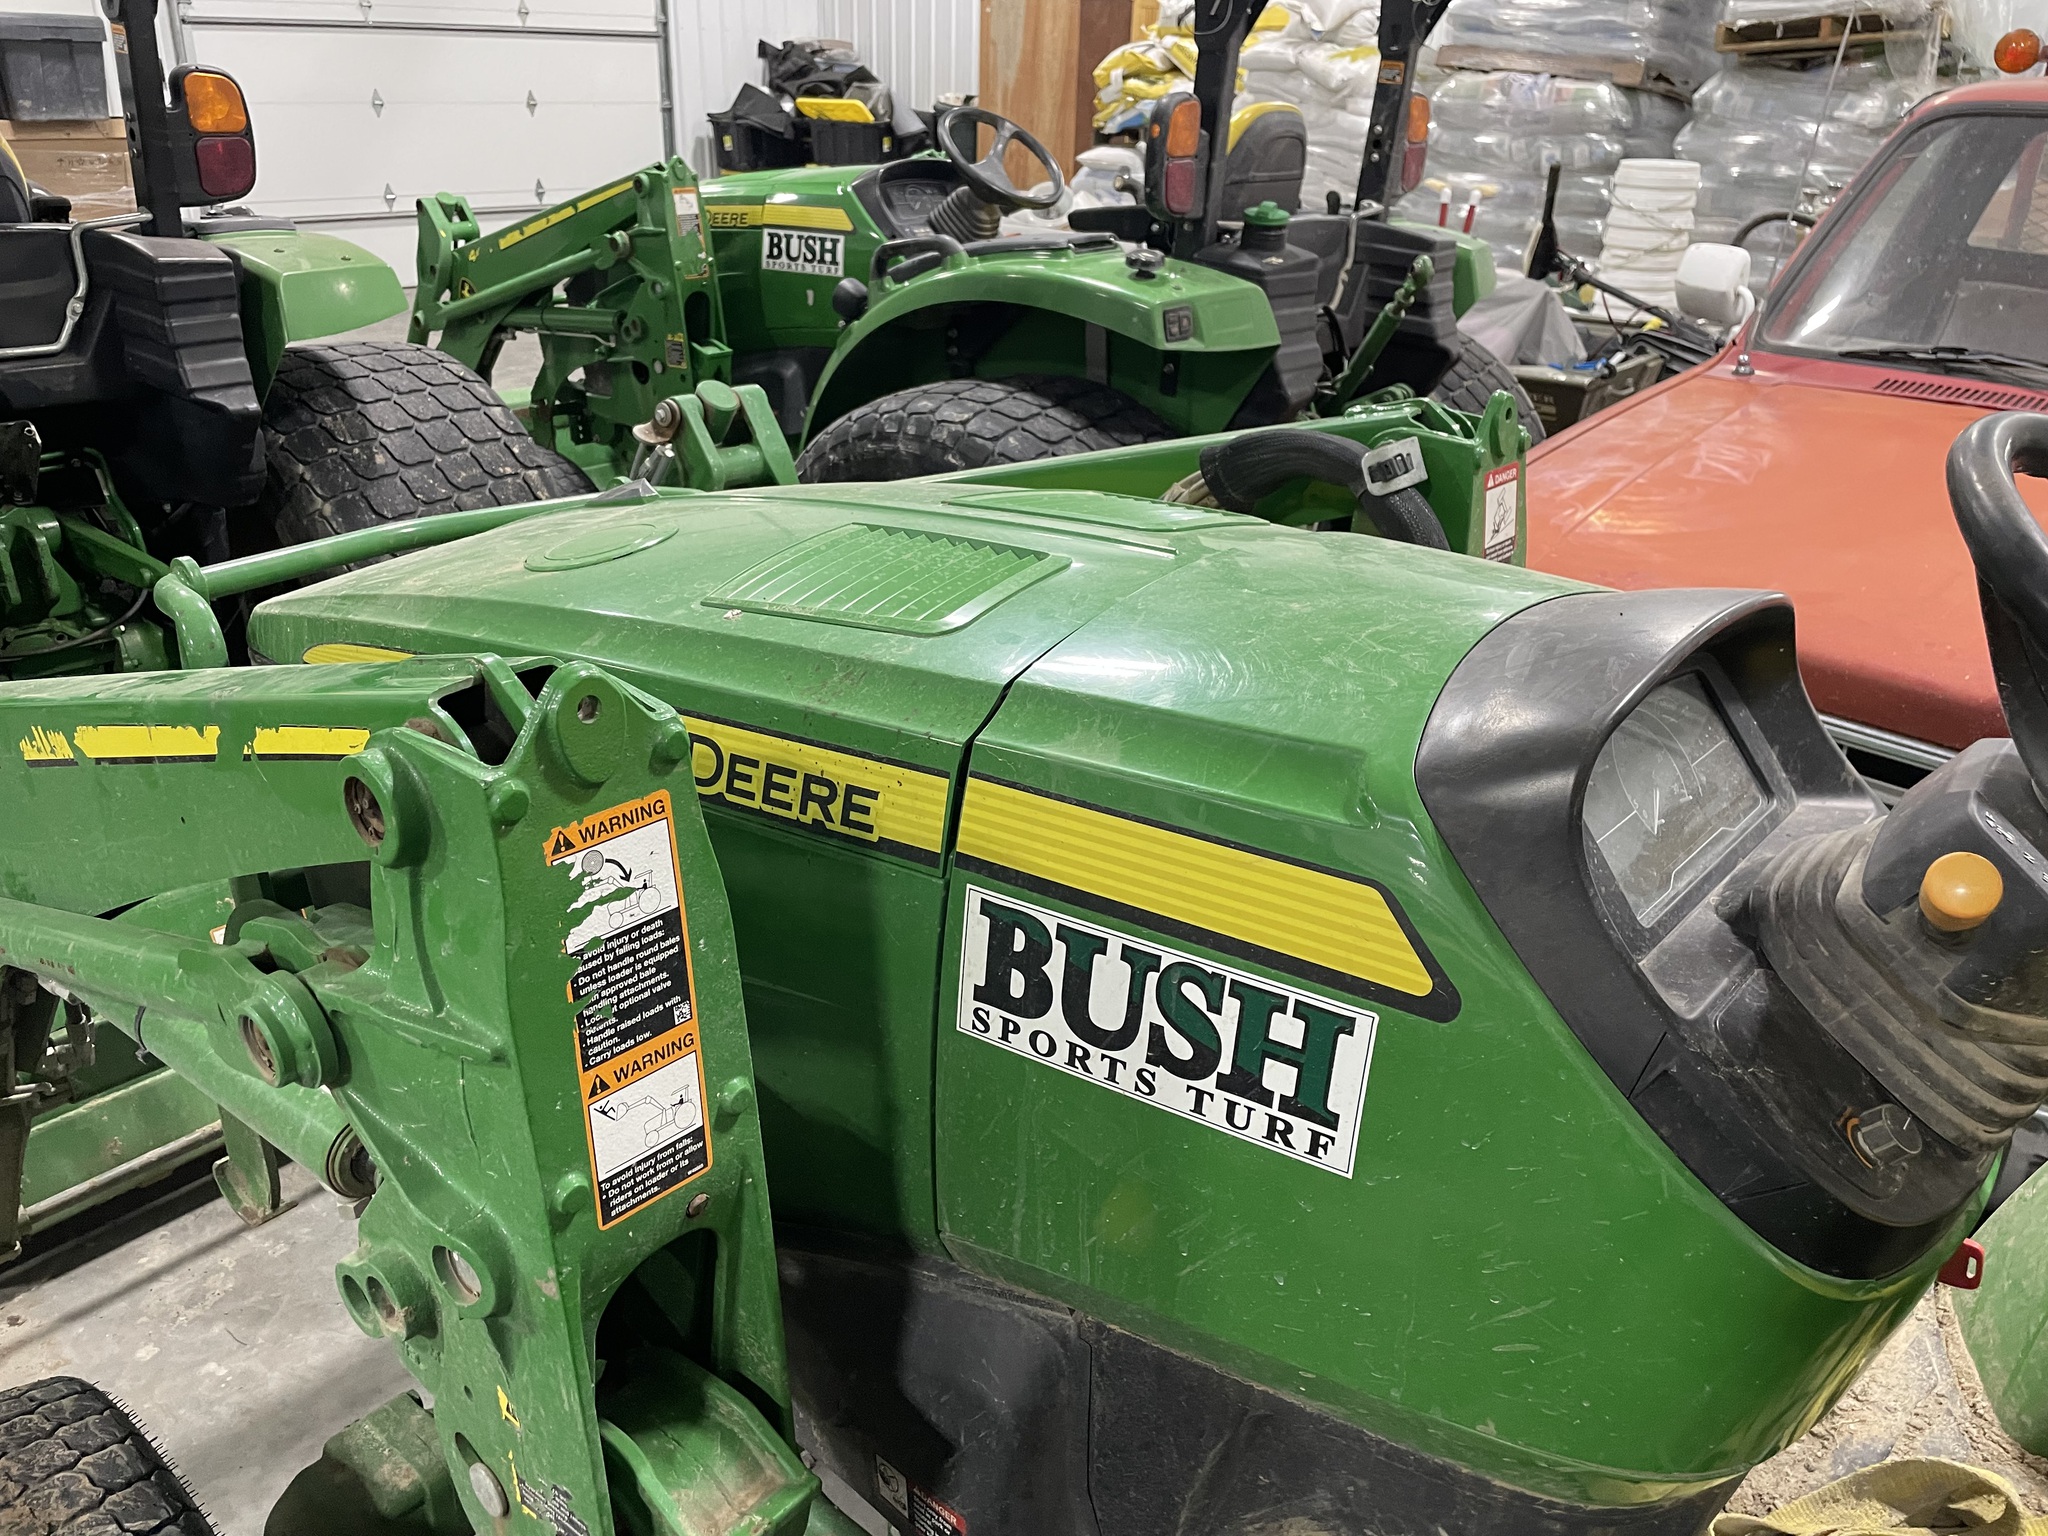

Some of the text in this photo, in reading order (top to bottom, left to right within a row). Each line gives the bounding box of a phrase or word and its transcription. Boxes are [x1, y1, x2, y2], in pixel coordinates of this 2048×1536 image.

[765, 260, 840, 275] SPORTS TURF
[767, 232, 840, 266] BUSH
[1494, 467, 1517, 485] DANGER
[691, 732, 881, 834] DEERE
[578, 799, 666, 843] WARNING
[577, 929, 666, 973] aused by falling loads:
[578, 935, 681, 986] Do not handle round bales
[582, 919, 664, 960] avoid injury or death
[580, 945, 679, 996] unless loader is equipped
[600, 974, 639, 998] approved
[639, 966, 657, 980] bale
[582, 971, 670, 1017] handling attachments.
[584, 1014, 603, 1027] Loc
[618, 988, 651, 1010] optional
[651, 980, 672, 994] valve
[973, 897, 1357, 1132] BUSH
[586, 995, 682, 1047] Handle raised loads with
[587, 1035, 621, 1056] caution.
[589, 1030, 653, 1066] Carry loads low.
[613, 1032, 695, 1083] WARNING
[971, 1006, 1337, 1160] SPORTS TURF
[600, 1137, 694, 1192] To avoid injury from falls:
[608, 1188, 620, 1198] Do
[621, 1179, 635, 1191] not
[635, 1168, 655, 1183] work
[655, 1157, 674, 1172] from
[675, 1151, 684, 1160] or
[684, 1140, 704, 1156] allow
[609, 1191, 633, 1208] riders
[633, 1183, 645, 1194] on
[645, 1170, 669, 1188] loader
[670, 1163, 679, 1173] or
[679, 1158, 690, 1168] its
[610, 1185, 661, 1217] attachments.
